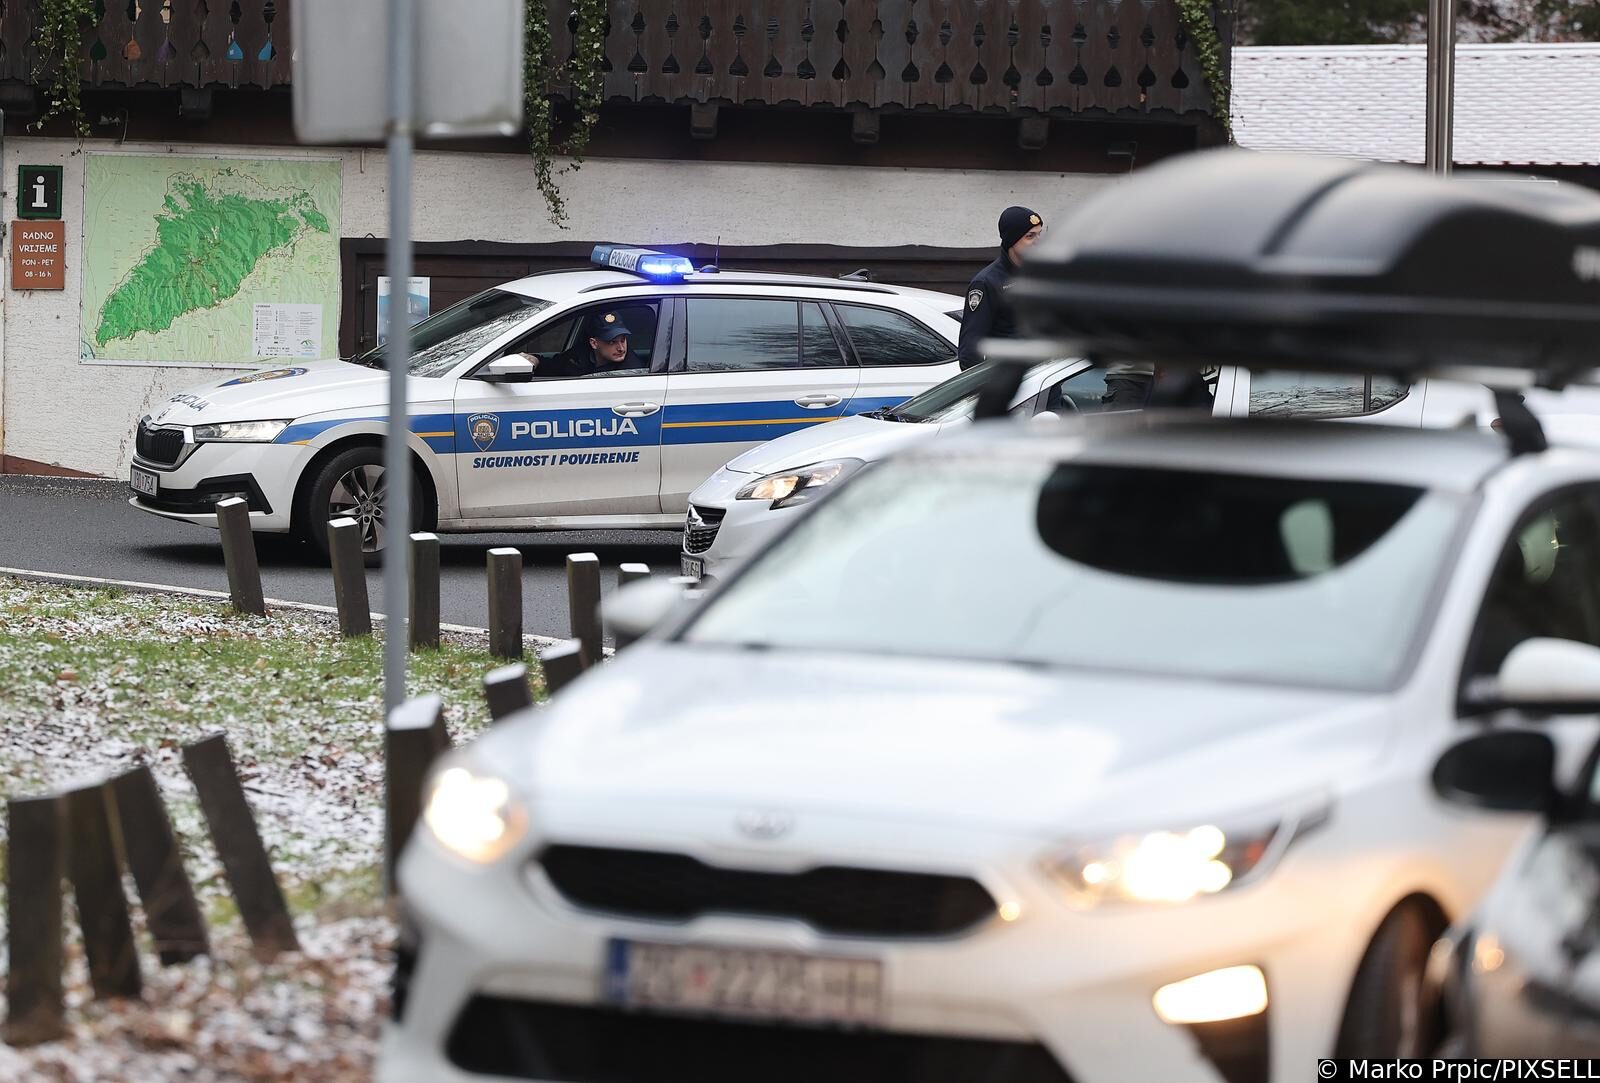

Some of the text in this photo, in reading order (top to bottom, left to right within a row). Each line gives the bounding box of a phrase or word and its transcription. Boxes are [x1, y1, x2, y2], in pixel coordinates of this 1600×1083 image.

[22, 231, 54, 241] RADNO
[19, 244, 58, 254] VRIJEME
[22, 259, 37, 267] PON
[41, 258, 55, 267] PET
[611, 251, 637, 270] POLICIJA
[24, 270, 34, 278] 08
[39, 270, 46, 278] 16
[47, 270, 52, 278] h
[470, 414, 498, 423] POLICIJA
[511, 418, 639, 440] POLICIJA
[473, 452, 640, 469] SIGURNOST I POVJERENJE
